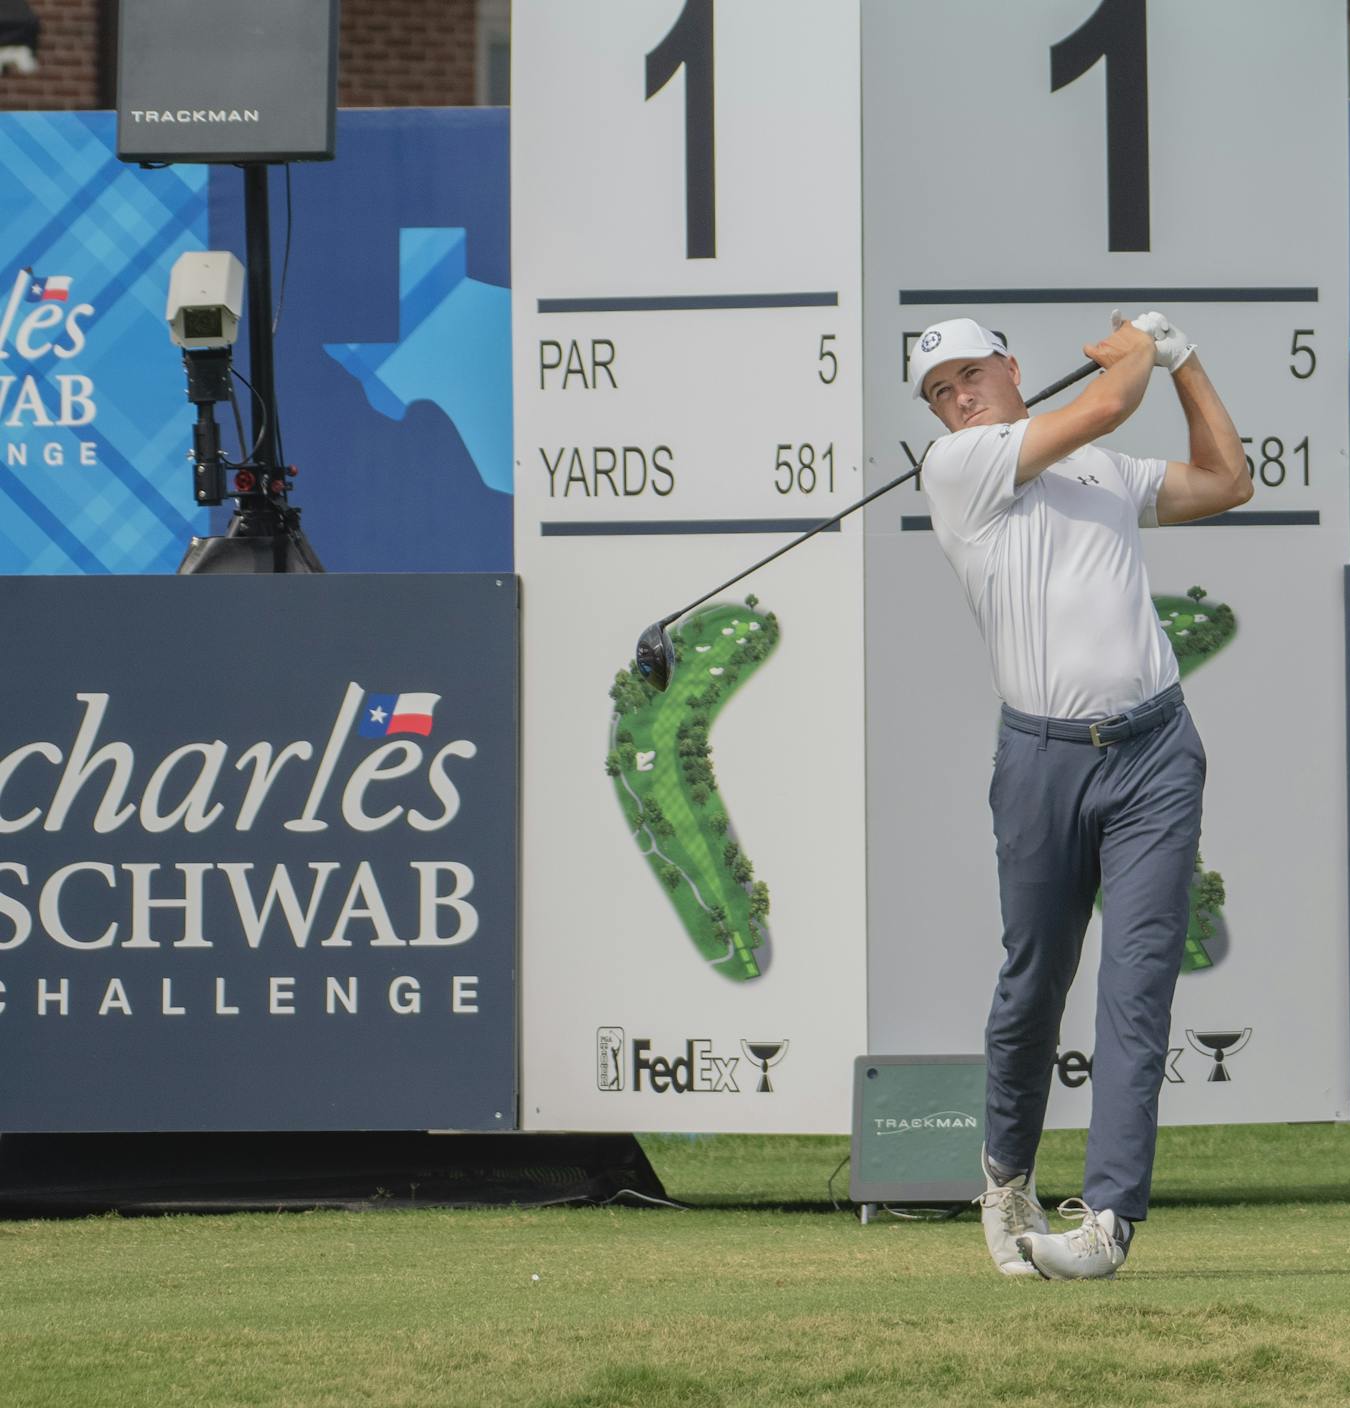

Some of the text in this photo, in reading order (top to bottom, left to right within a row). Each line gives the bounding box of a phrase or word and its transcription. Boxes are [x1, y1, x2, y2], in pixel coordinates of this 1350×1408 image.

[130, 109, 260, 123] TRACKMAN
[645, 0, 717, 260] 1
[1049, 0, 1151, 253] 1
[539, 334, 838, 391] PAR 5
[1289, 329, 1317, 380] 5
[539, 442, 835, 498] YARDS 581
[0, 681, 477, 834] charles
[0, 975, 480, 1016] HALLENGE
[632, 1038, 741, 1094] FedEx
[874, 1117, 977, 1129] TRACKMAN
